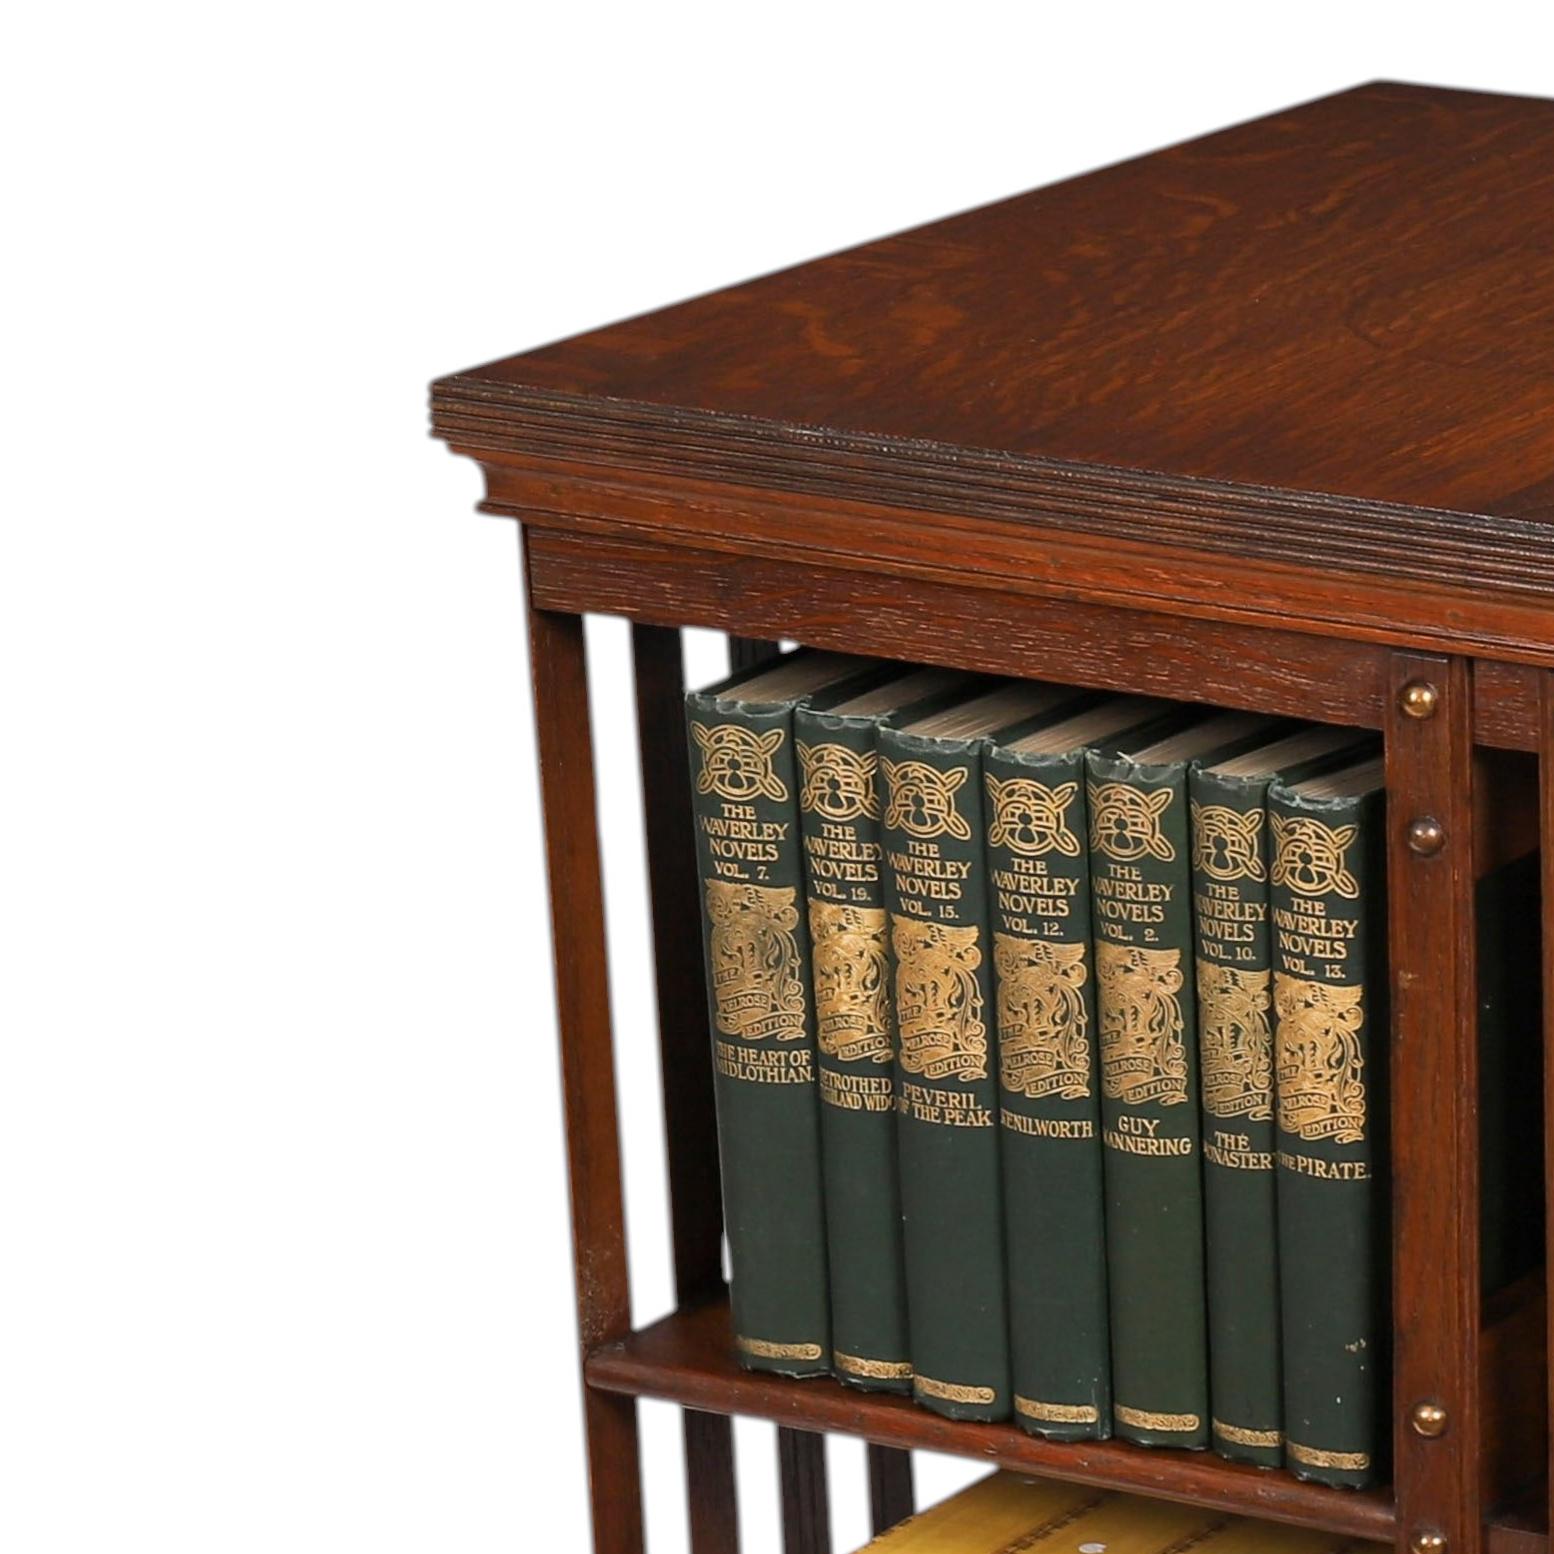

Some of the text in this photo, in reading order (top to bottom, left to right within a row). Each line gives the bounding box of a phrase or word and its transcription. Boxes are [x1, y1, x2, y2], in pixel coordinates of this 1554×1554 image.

[721, 803, 756, 819] THE
[821, 823, 856, 840] THE
[709, 838, 779, 861] NOVELS
[907, 841, 940, 858] THE
[714, 861, 770, 880] VOL. 7.
[810, 856, 879, 881] NOVELS
[1011, 857, 1048, 875] THE
[1107, 863, 1142, 880] THE
[813, 880, 872, 901] VOL. 19.
[896, 873, 962, 900] NOVELS
[1206, 882, 1240, 900] THE
[900, 897, 959, 919] VOL. 15.
[999, 891, 1070, 917] NOVELS
[1097, 898, 1164, 923] NOVELS
[1196, 893, 1267, 921] AVERLEY
[1291, 897, 1326, 916] THE
[1001, 914, 1064, 936] VOL. 12.
[1101, 921, 1159, 941] VOL. 2.
[1200, 915, 1254, 942] NOVELS
[1202, 939, 1256, 960] VOL. 10.
[1279, 930, 1347, 959] NOVELS
[1282, 954, 1346, 979] VOL. 13.
[743, 1014, 800, 1036] EDITION
[841, 1036, 887, 1056] EDITIO
[737, 1047, 788, 1067] HEART
[789, 1050, 811, 1066] OF
[929, 1054, 980, 1074] EDITION
[1028, 1072, 1084, 1094] EDITION
[1127, 1079, 1181, 1099] EDITION
[902, 1081, 982, 1110] PEVERIL
[912, 1103, 941, 1123] THE
[1118, 1115, 1160, 1137] GUY
[1304, 1117, 1359, 1137] EDITION
[1215, 1131, 1251, 1151] THE
